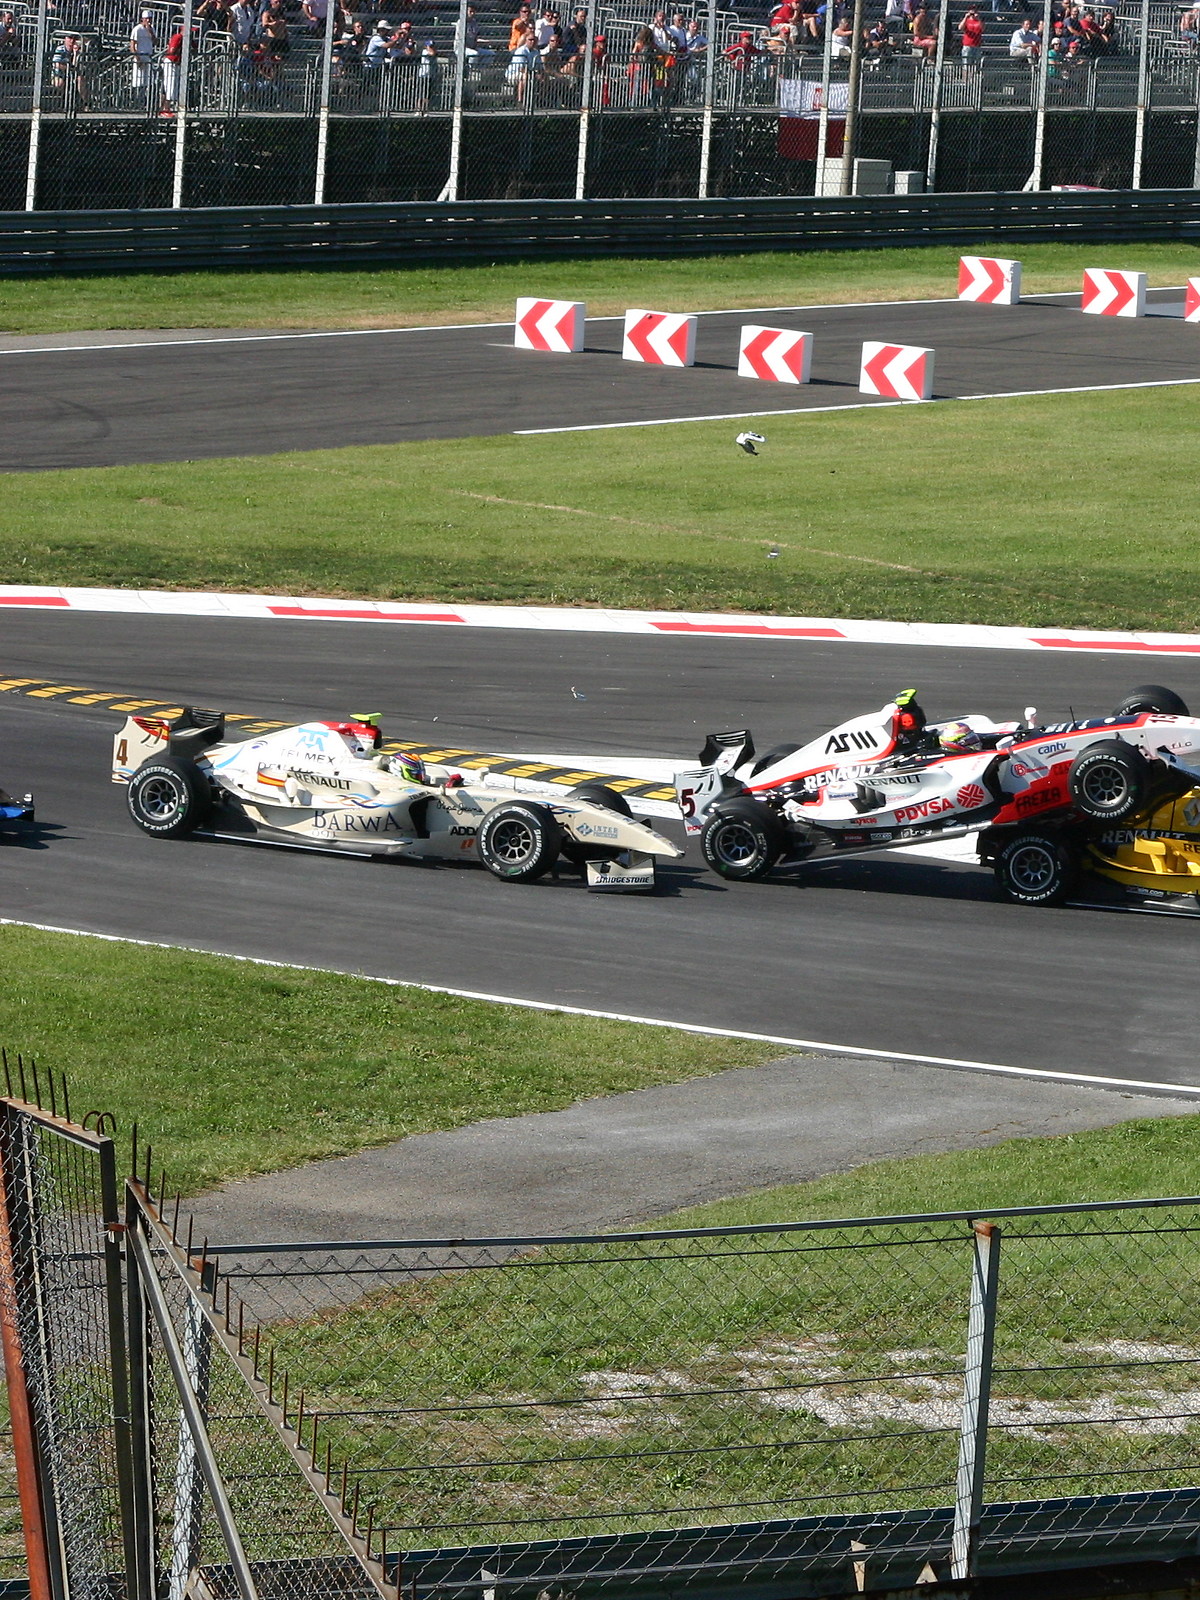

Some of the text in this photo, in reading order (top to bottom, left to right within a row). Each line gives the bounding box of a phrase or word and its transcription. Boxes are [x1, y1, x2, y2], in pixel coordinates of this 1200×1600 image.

[116, 739, 128, 766] 4
[1038, 742, 1067, 755] cantv
[295, 772, 352, 791] RENAULT
[803, 764, 880, 790] RENAULT
[861, 774, 921, 787] RENAULT
[681, 788, 696, 818] 5
[893, 797, 955, 824] PDVSA
[312, 810, 402, 832] BARWA
[450, 826, 479, 836] ADDA
[595, 876, 650, 884] BRIDGESTONE
